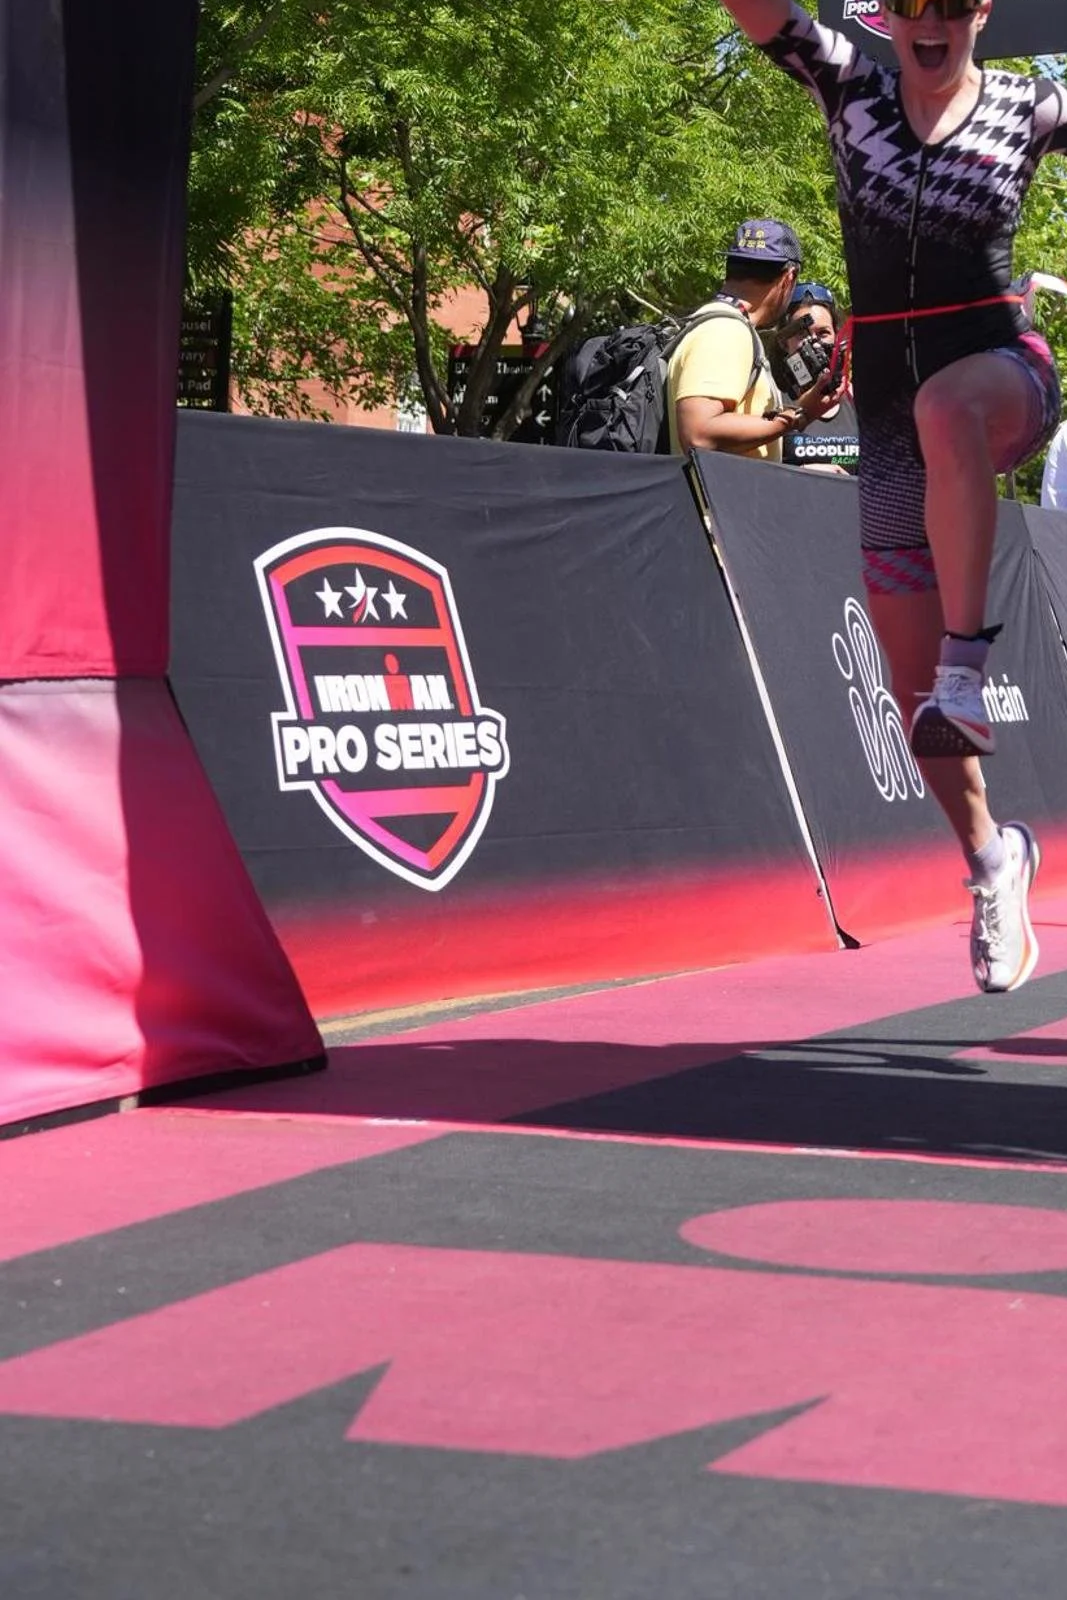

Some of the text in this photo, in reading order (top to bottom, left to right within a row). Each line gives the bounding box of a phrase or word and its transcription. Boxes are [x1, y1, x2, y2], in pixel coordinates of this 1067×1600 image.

[847, 0, 880, 15] PRO
[180, 319, 212, 331] ousel
[313, 653, 454, 713] IRONMAN
[281, 720, 503, 776] PRO SERIES
